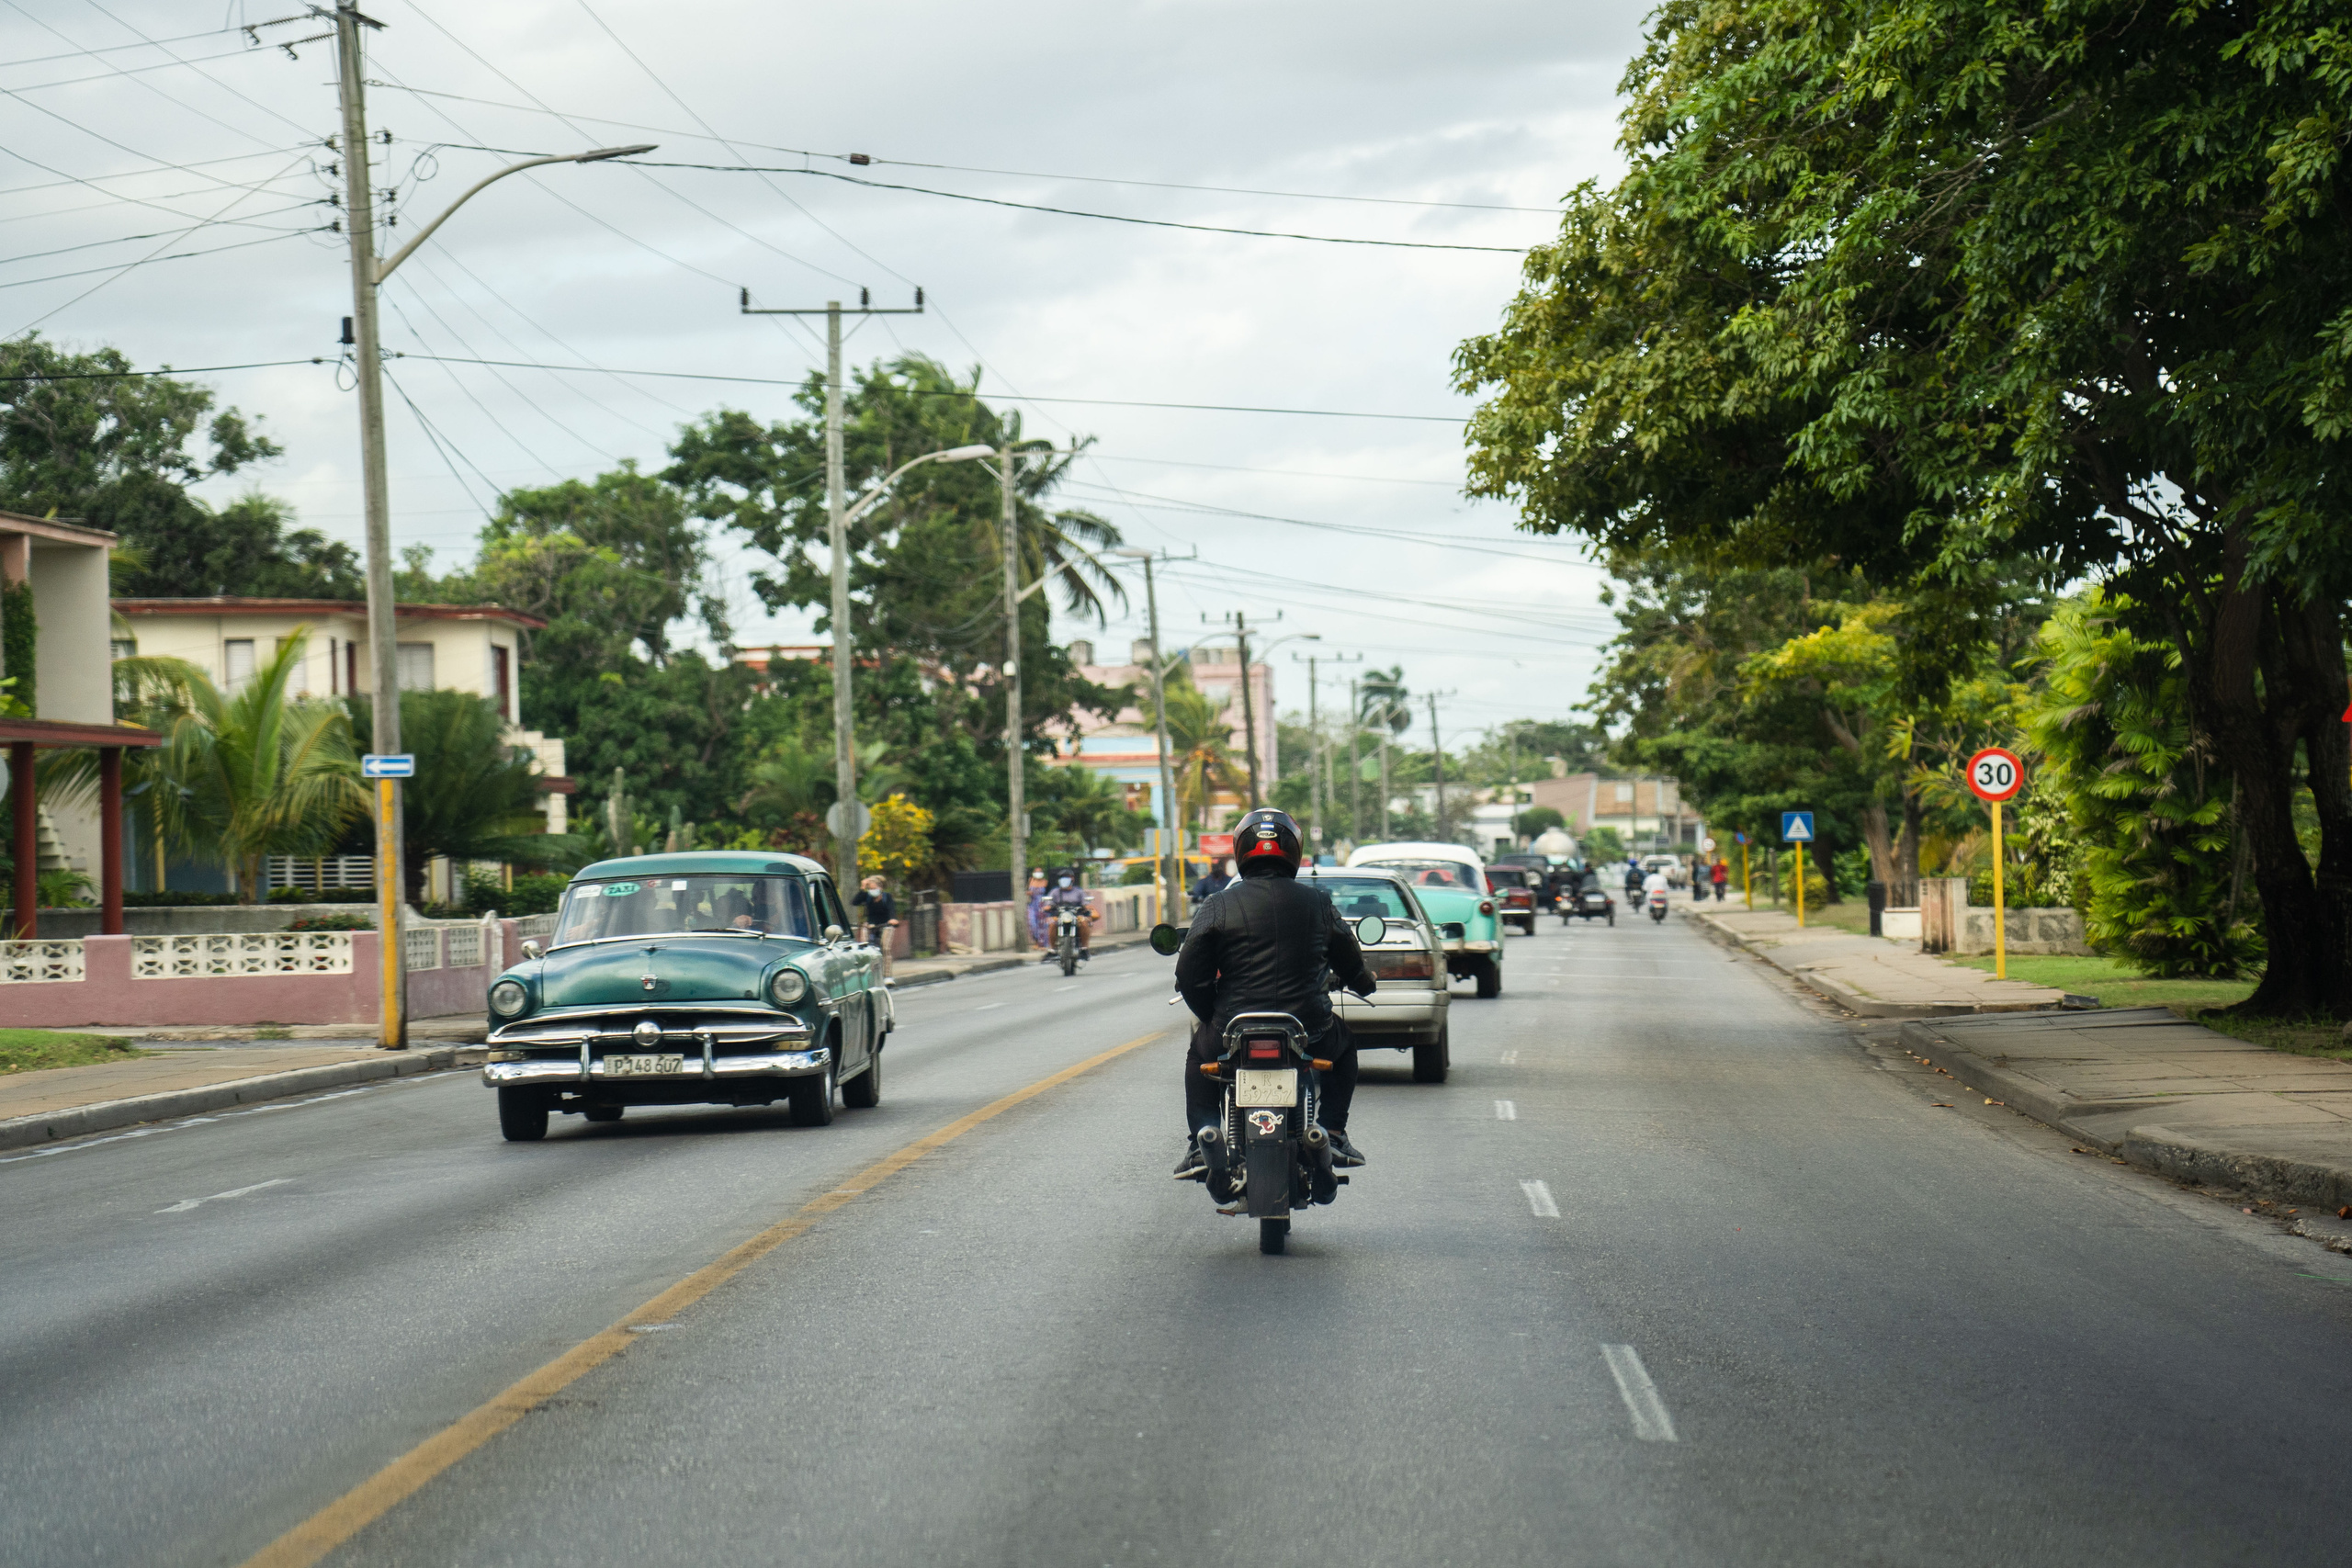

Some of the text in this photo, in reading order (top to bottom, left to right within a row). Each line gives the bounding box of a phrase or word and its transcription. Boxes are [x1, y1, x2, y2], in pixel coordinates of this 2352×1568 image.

[1978, 763, 2012, 785] 30
[608, 885, 636, 895] TAXI
[615, 1059, 623, 1073] P
[627, 1058, 651, 1072] 148
[655, 1057, 681, 1073] 607
[1261, 1072, 1272, 1086] R
[1242, 1089, 1292, 1103] 59757
